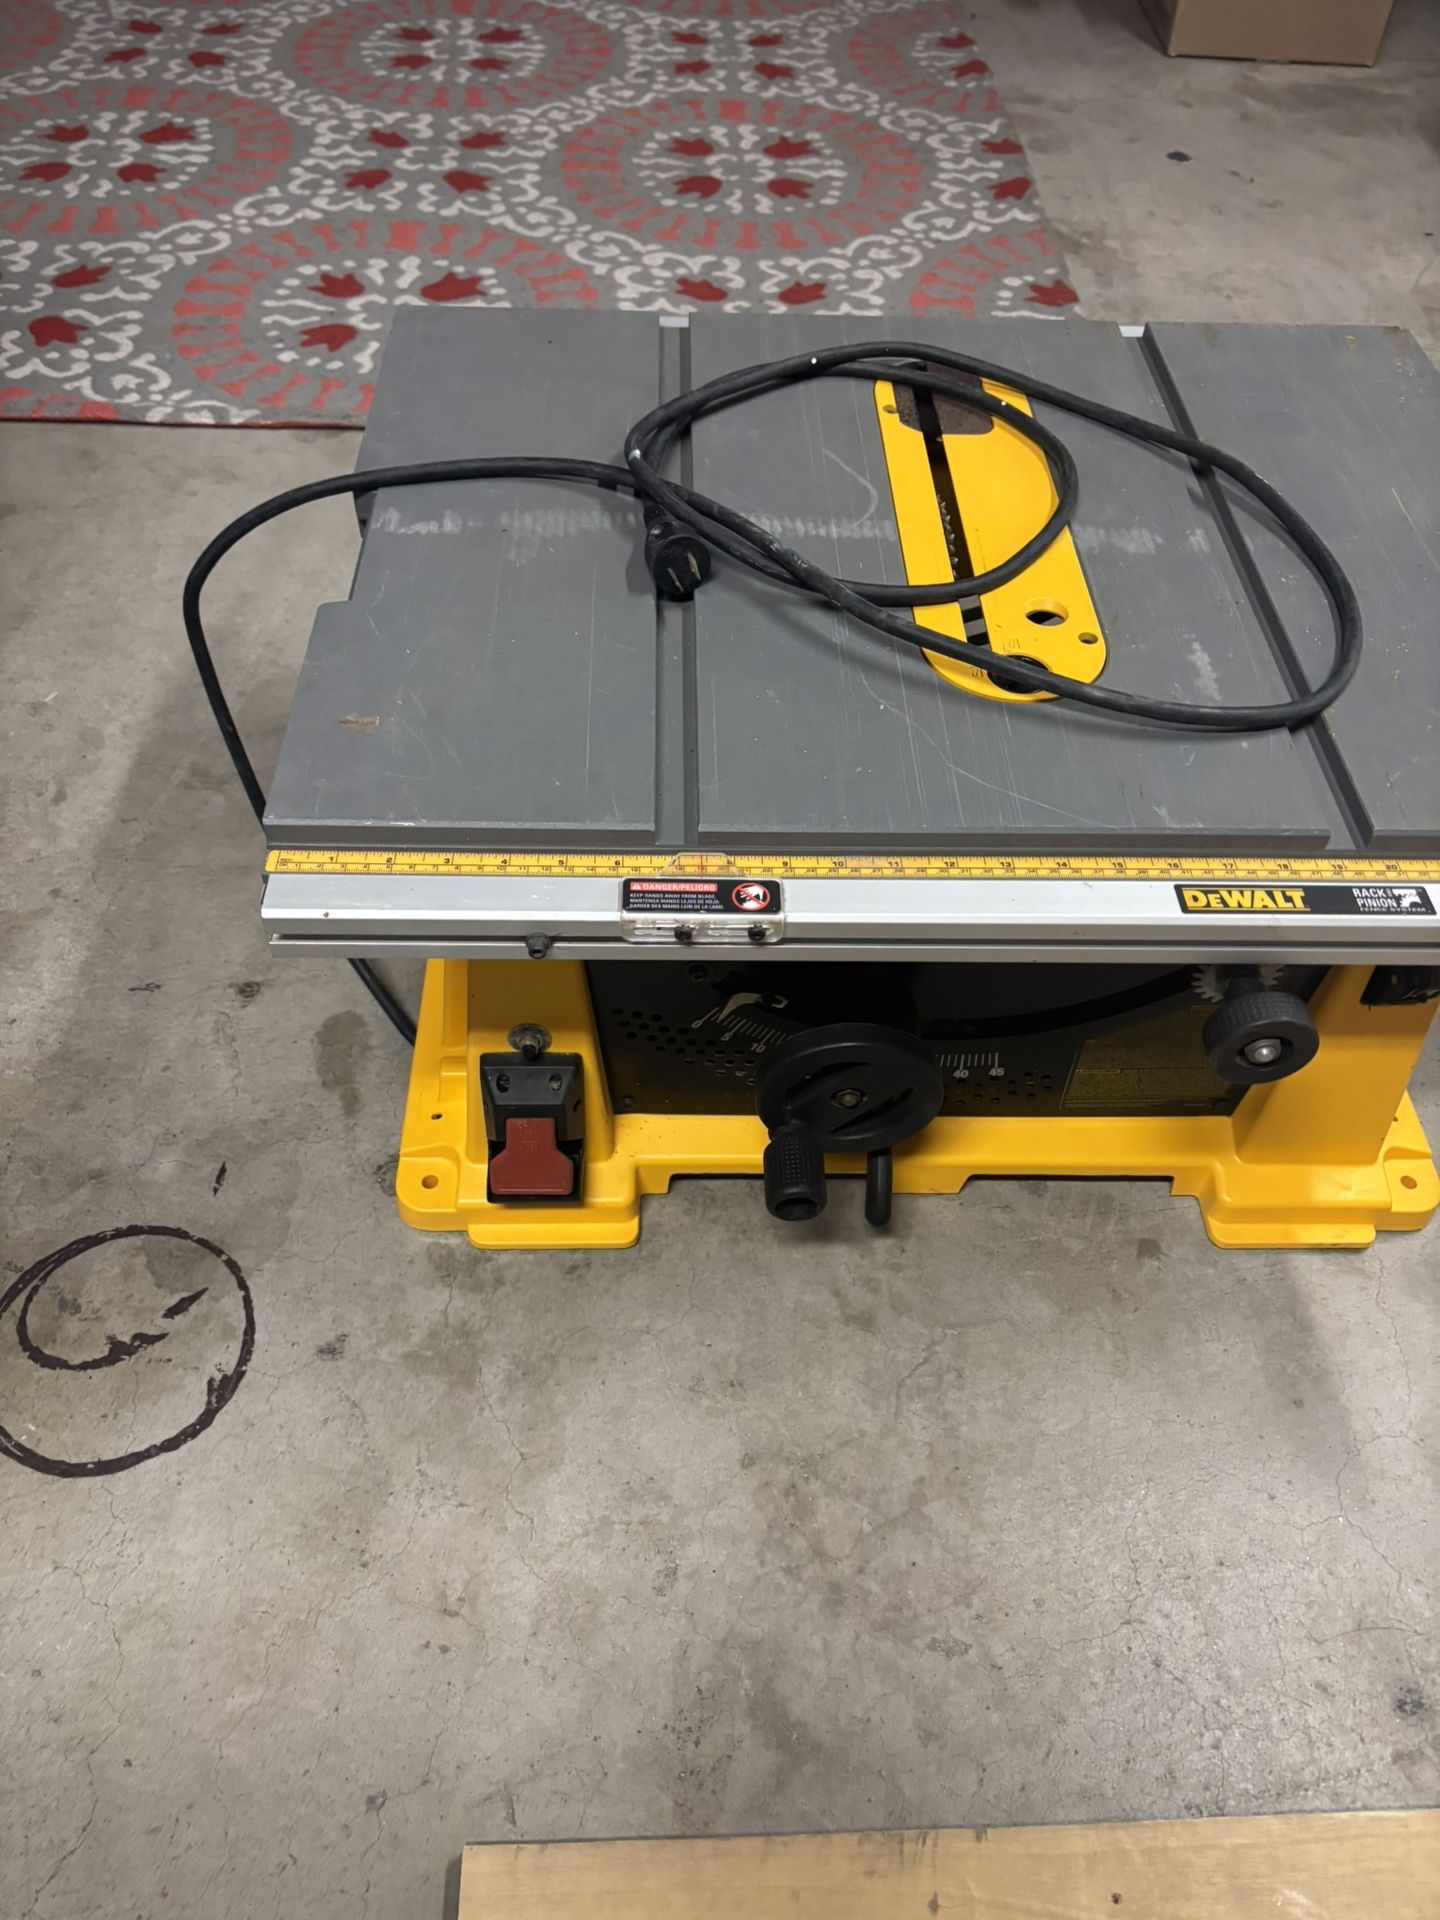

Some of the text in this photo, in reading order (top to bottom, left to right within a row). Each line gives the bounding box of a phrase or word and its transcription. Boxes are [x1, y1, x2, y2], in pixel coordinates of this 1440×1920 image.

[642, 884, 716, 892] DANGER/PELIGRO
[1352, 888, 1387, 898] RACK
[1356, 898, 1398, 908] PINION
[690, 1020, 766, 1053] 0 5 10
[953, 1067, 1004, 1079] 40 45
